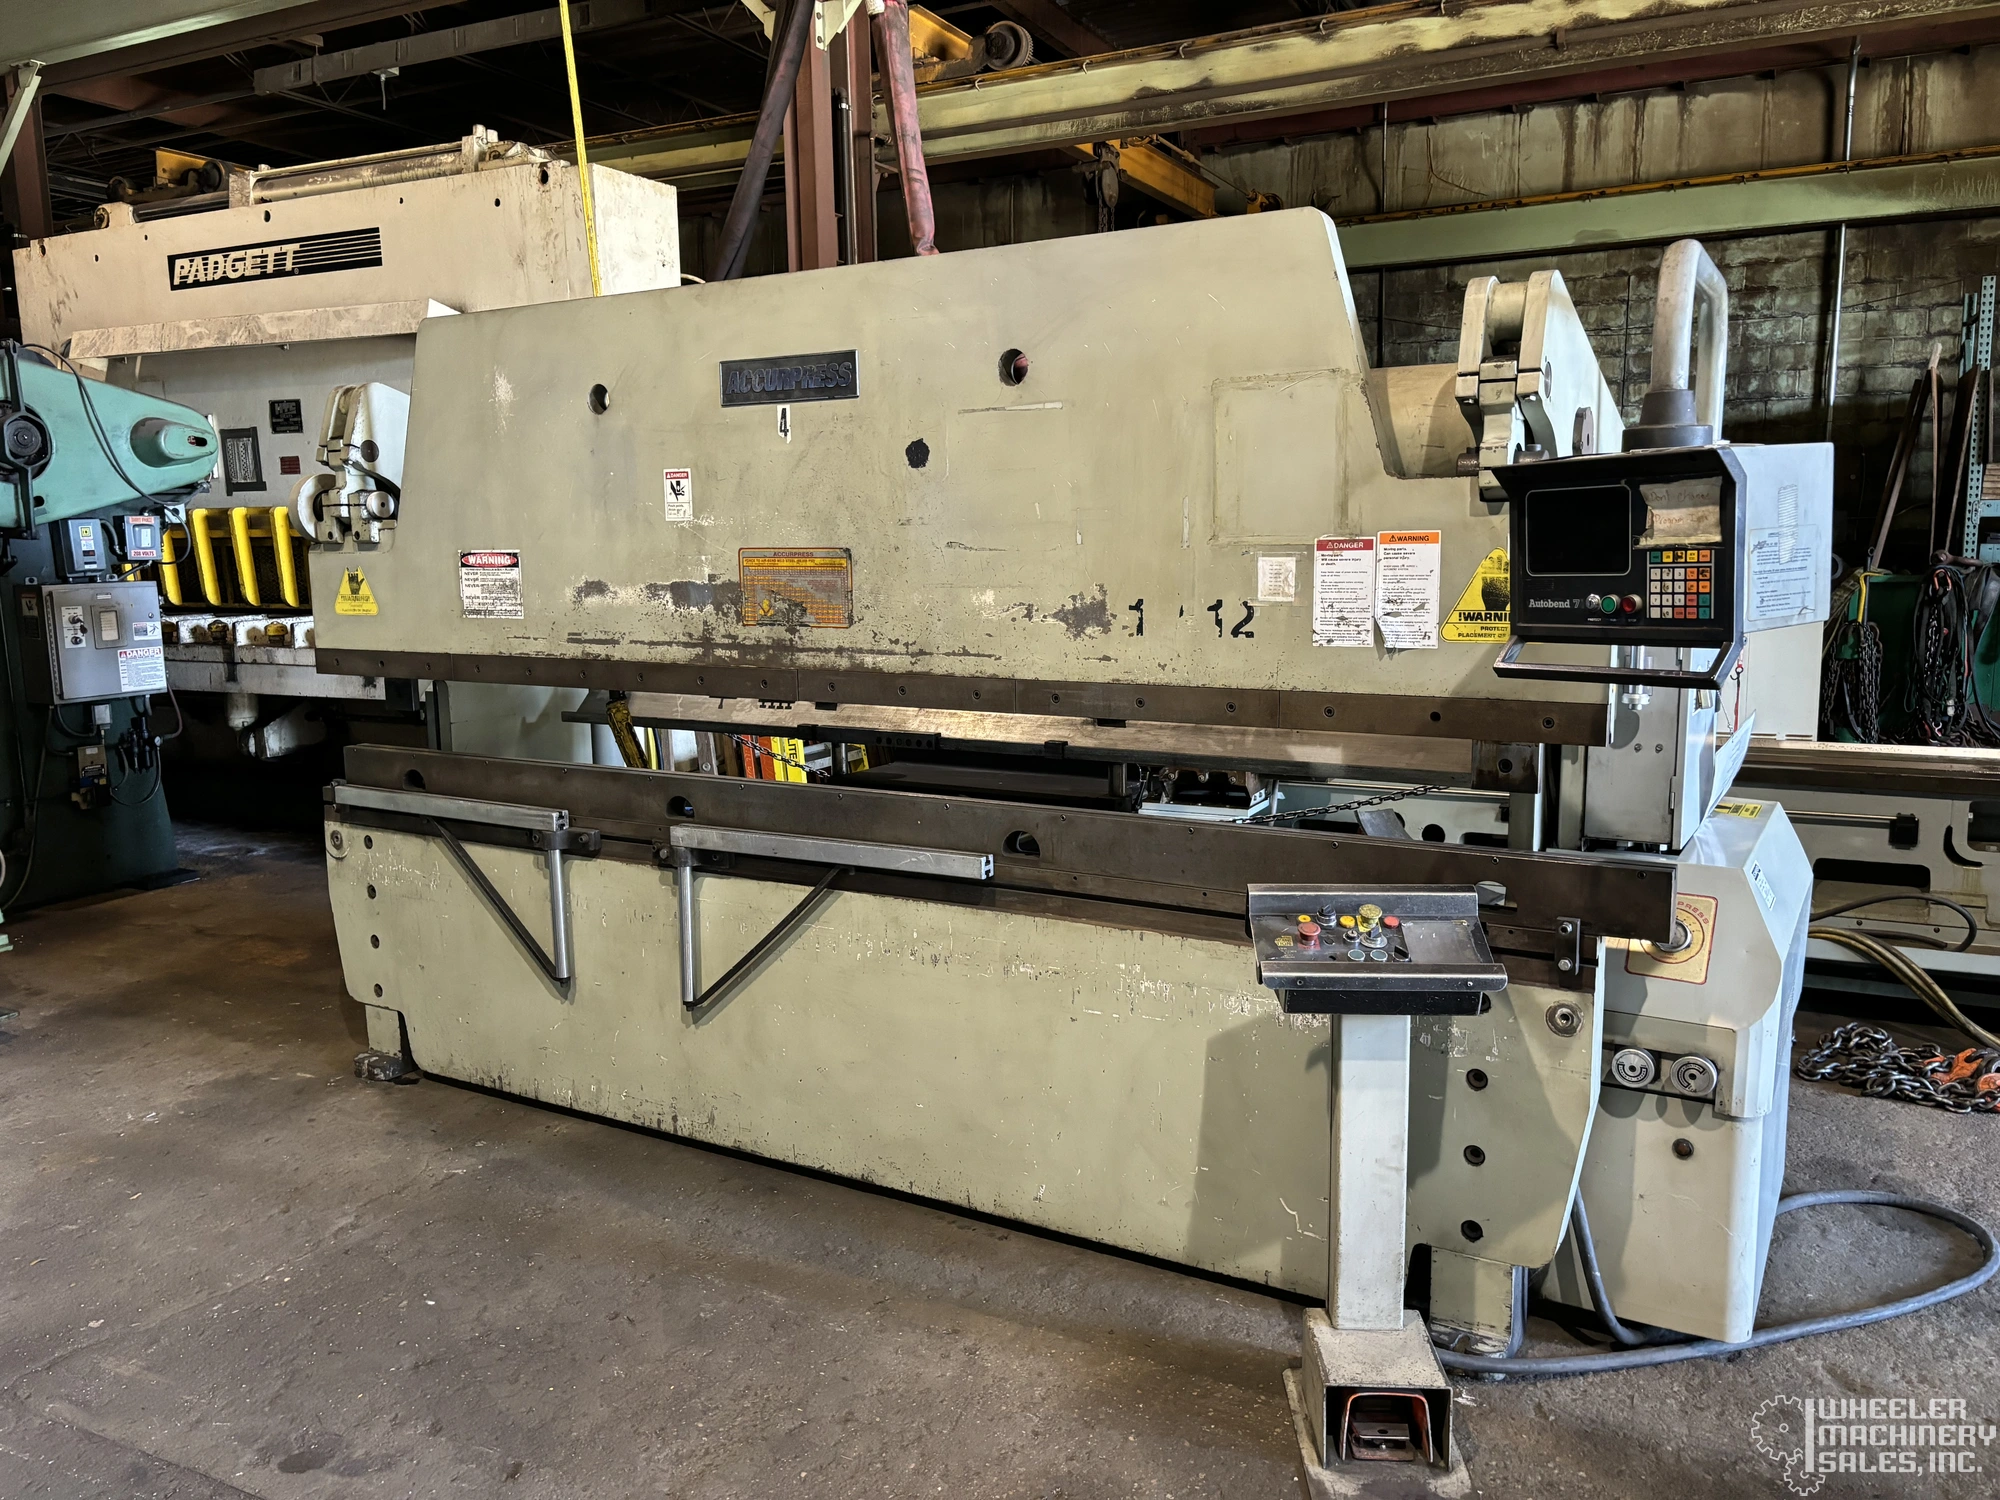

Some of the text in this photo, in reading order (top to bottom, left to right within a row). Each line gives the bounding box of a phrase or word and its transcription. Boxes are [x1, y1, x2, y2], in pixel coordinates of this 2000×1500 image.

[173, 243, 300, 286] PADGETT
[726, 362, 852, 395] ACCURPRESS
[779, 407, 790, 437] 4
[467, 555, 511, 564] WARNING
[1528, 598, 1571, 609] Autobend
[127, 647, 161, 658] DANGER
